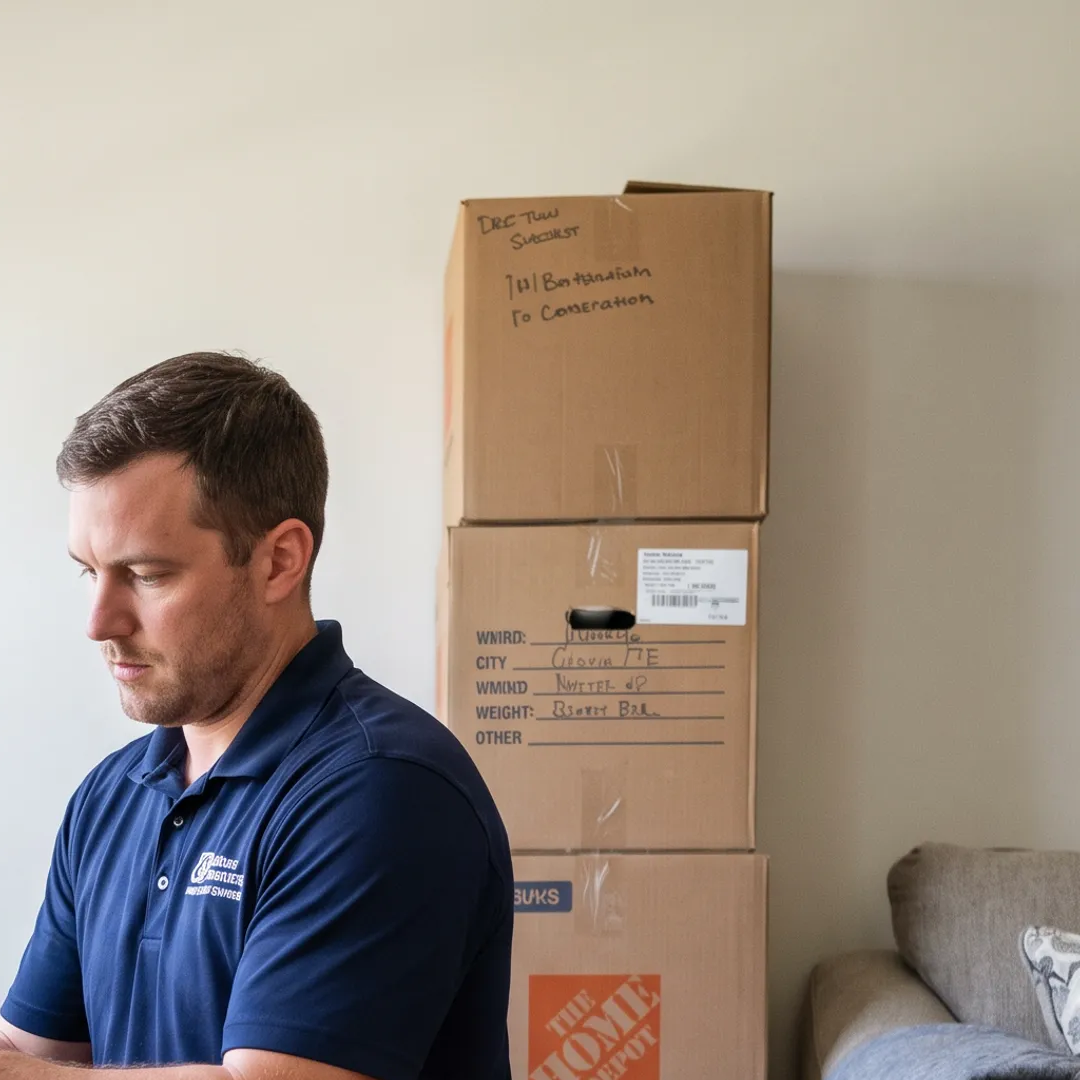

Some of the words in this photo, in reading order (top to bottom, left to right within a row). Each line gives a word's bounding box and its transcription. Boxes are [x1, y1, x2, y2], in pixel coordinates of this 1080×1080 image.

[476, 655, 508, 670] CITY
[476, 705, 535, 720] WEIGHT:
[476, 730, 523, 745] OTHER
[544, 988, 596, 1038] THE
